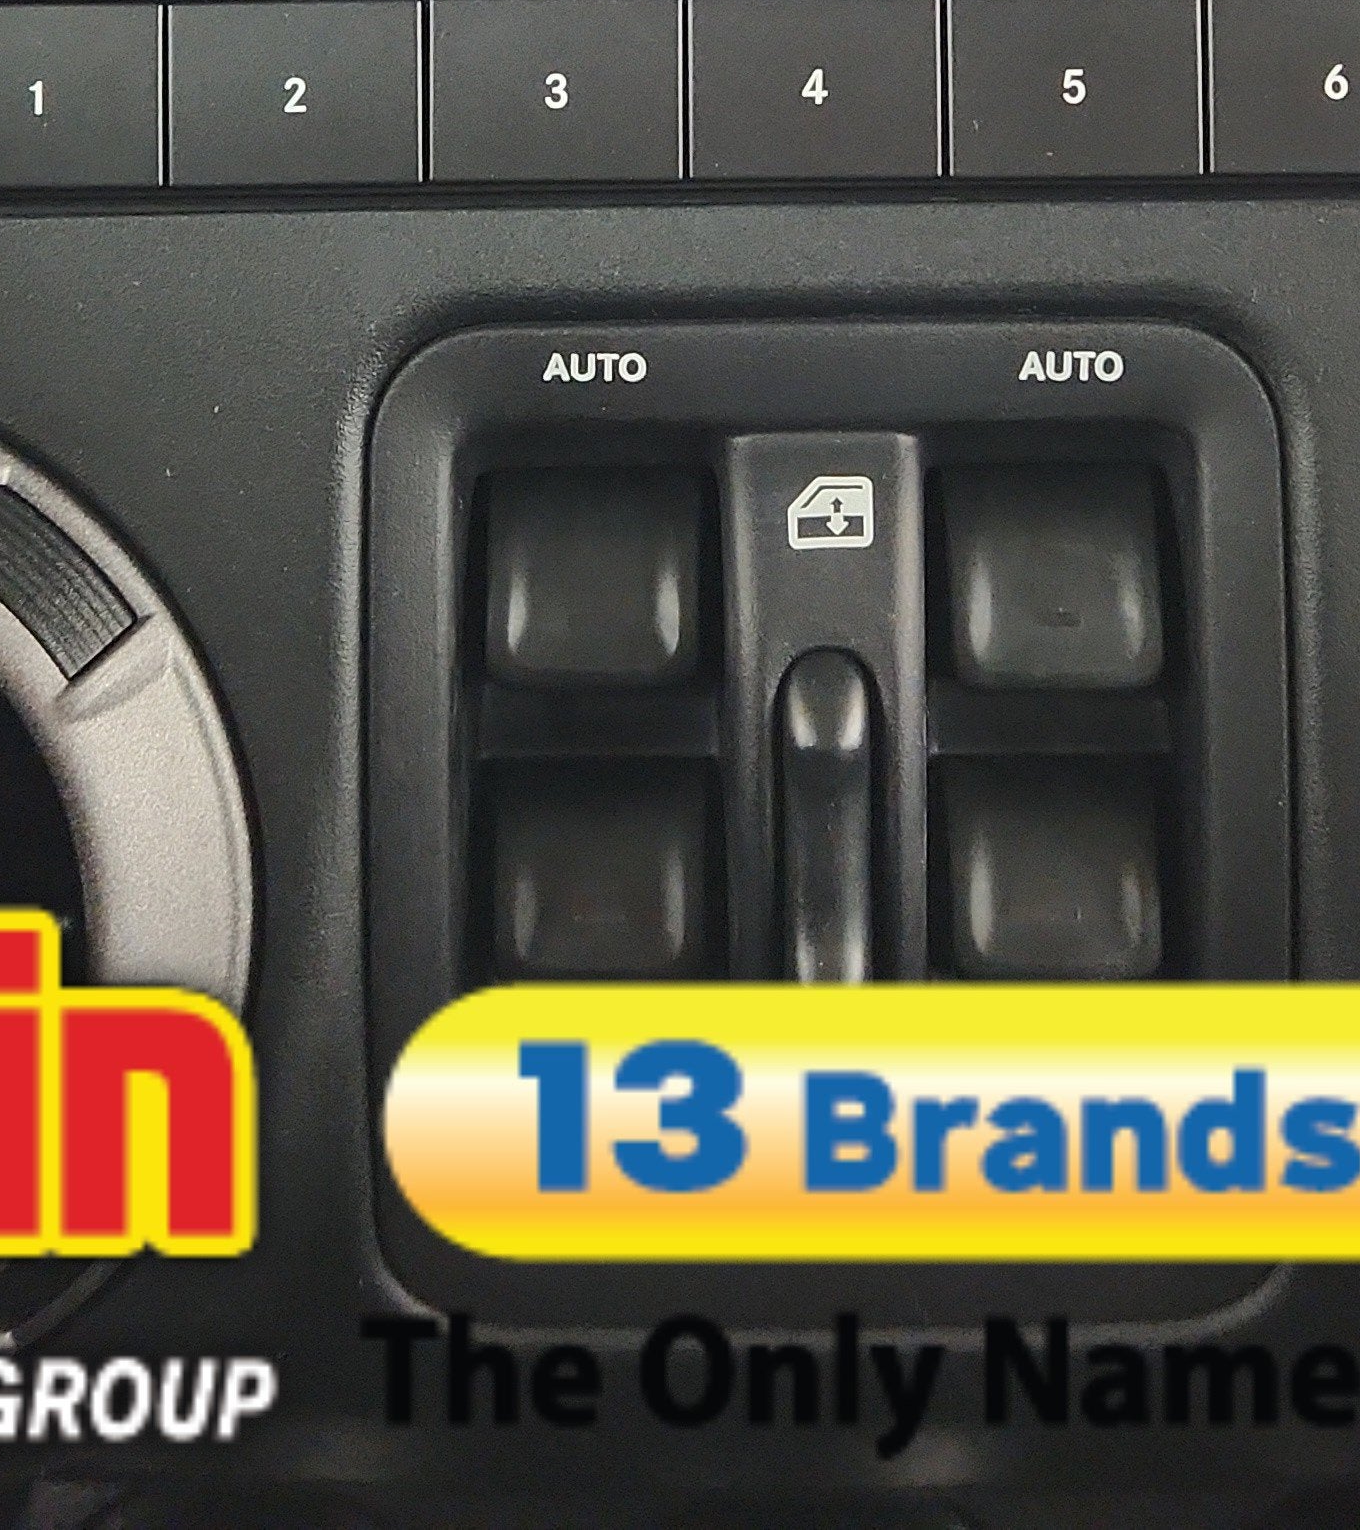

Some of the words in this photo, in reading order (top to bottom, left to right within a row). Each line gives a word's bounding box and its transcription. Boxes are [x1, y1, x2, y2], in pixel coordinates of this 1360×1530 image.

[28, 80, 43, 116] 1
[283, 77, 307, 113] 2
[544, 73, 569, 109] 3
[801, 68, 829, 105] 4
[1062, 68, 1086, 105] 5
[1324, 63, 1349, 100] 6
[542, 352, 647, 383] AUTO
[1018, 350, 1124, 382] AUTO
